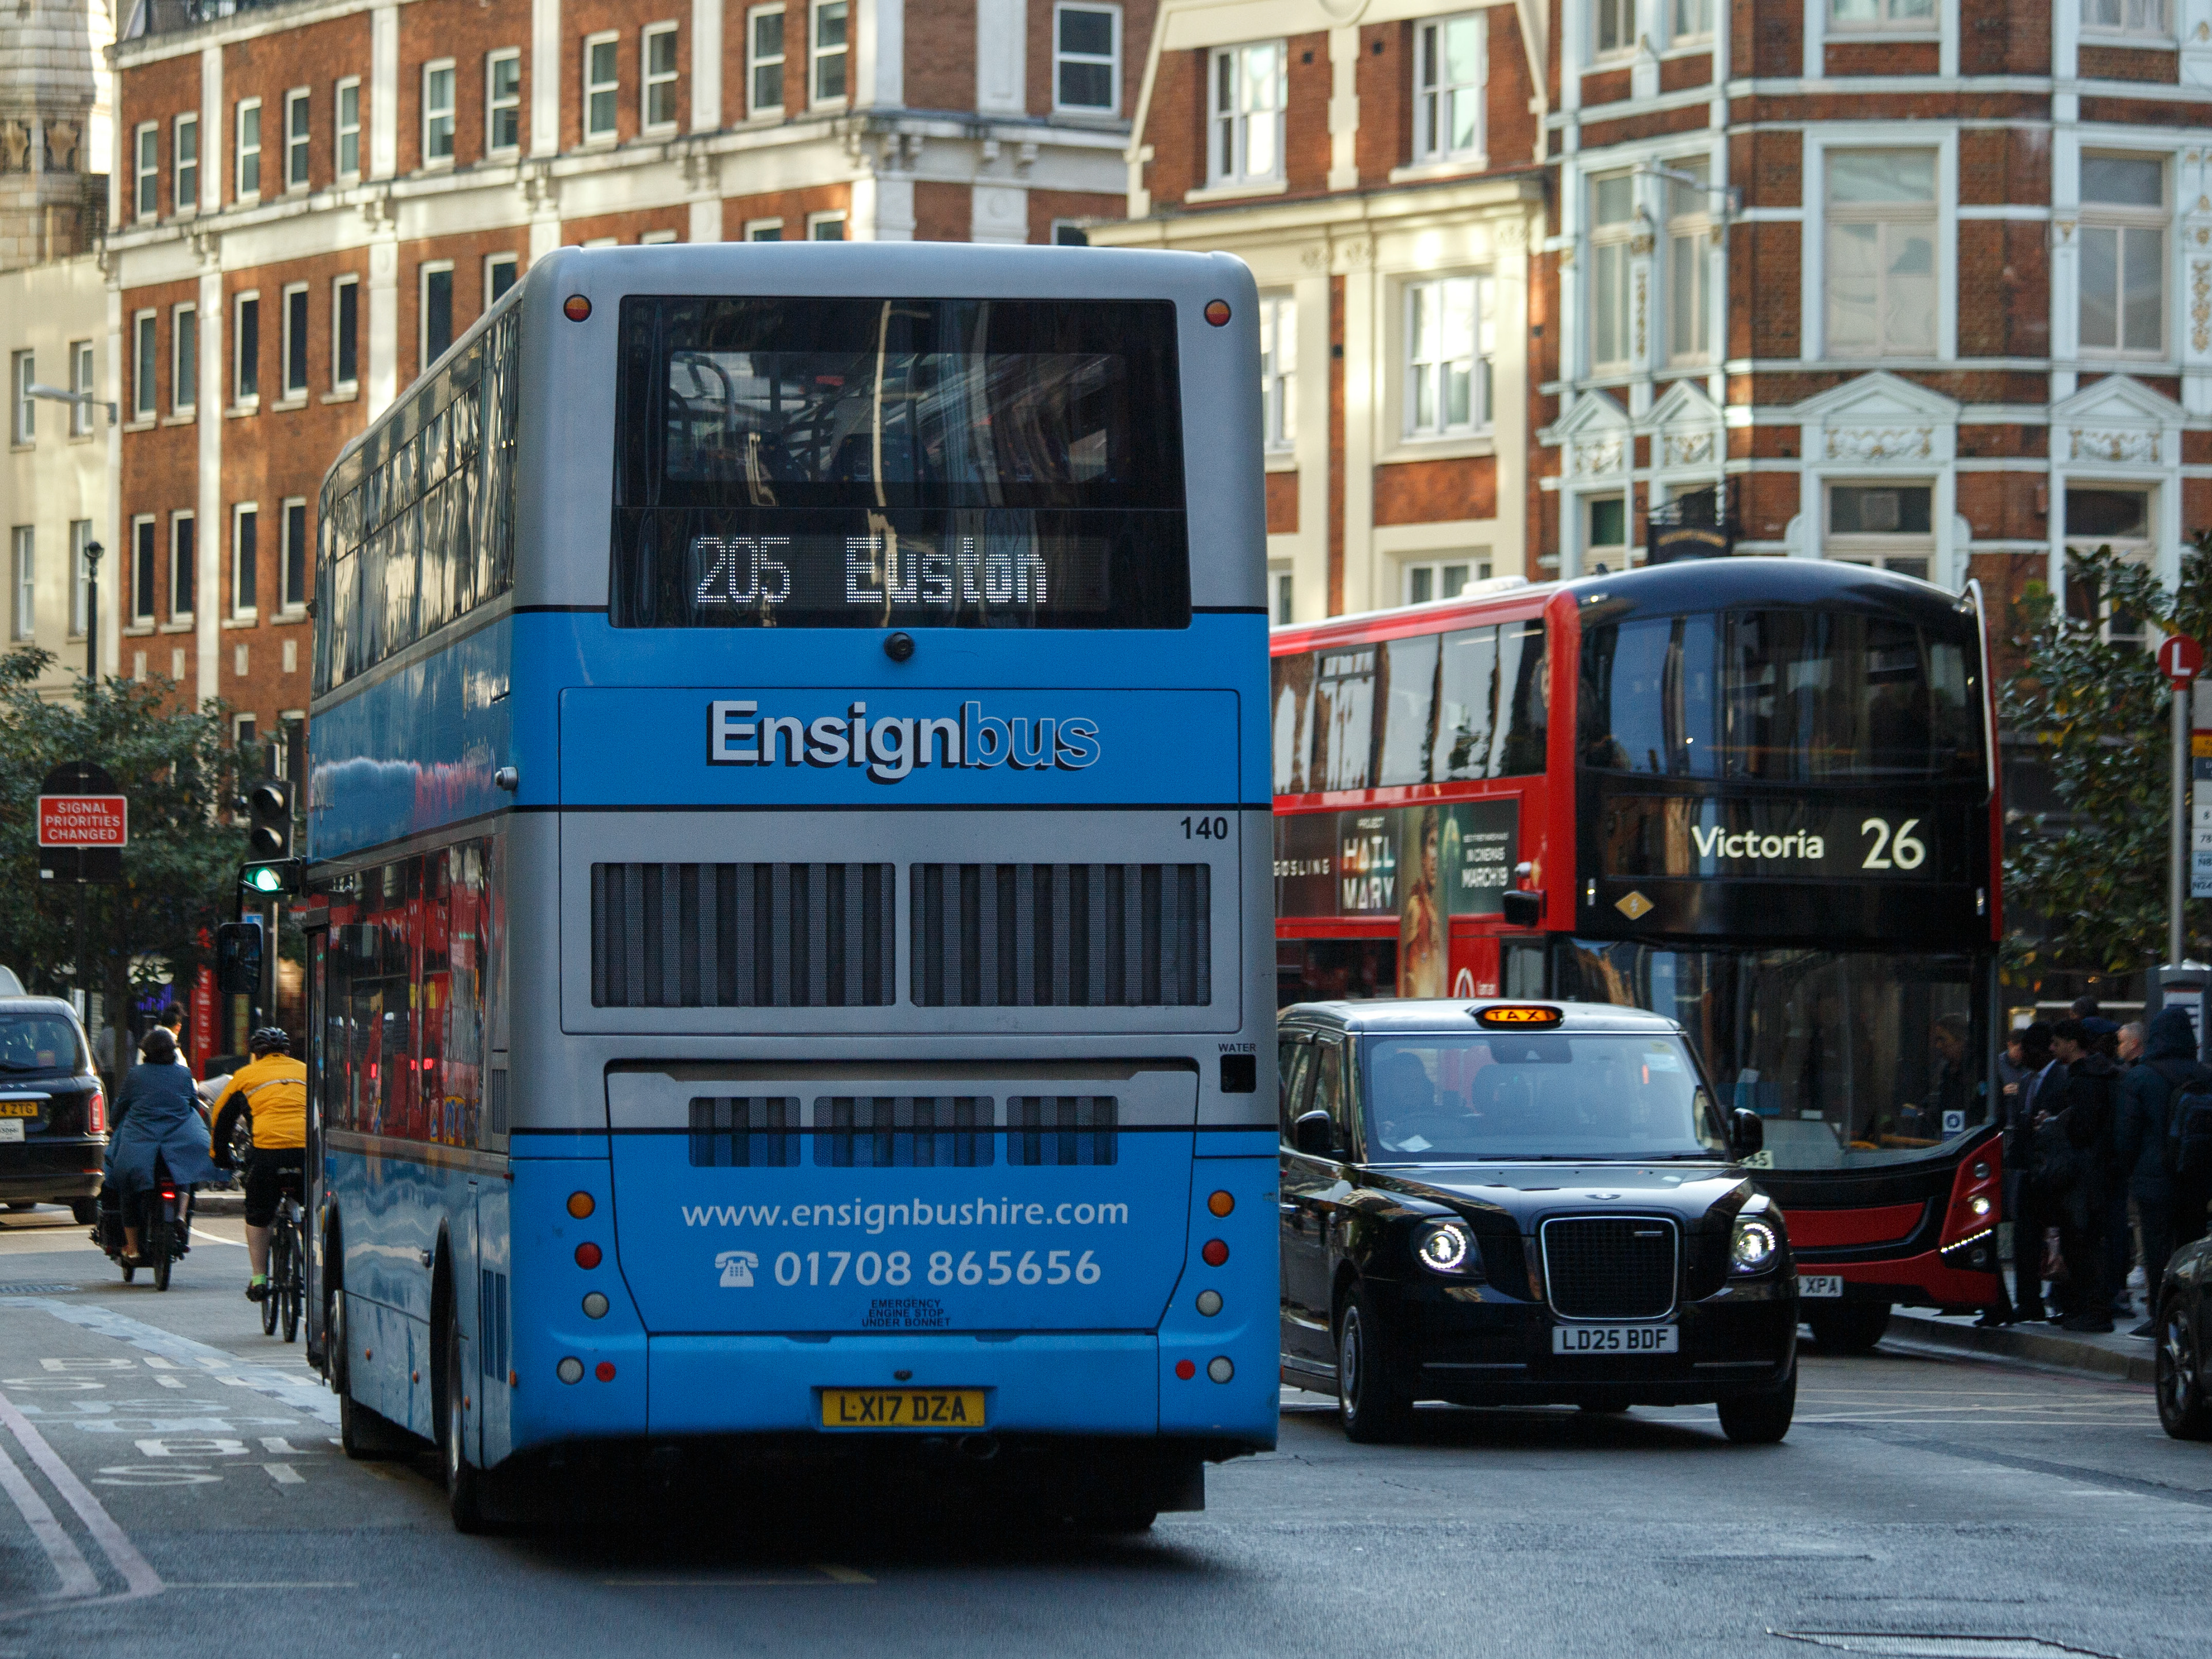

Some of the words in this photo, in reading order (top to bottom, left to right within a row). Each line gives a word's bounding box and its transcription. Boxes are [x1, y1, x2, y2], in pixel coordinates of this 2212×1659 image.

[697, 537, 790, 603] 205
[846, 537, 1047, 603] Euston
[2172, 642, 2192, 676] L
[706, 700, 1101, 786] Ensignbus
[58, 802, 108, 813] SIGNAL
[45, 815, 120, 827] PRIORITIES
[1181, 816, 1228, 840] 140
[48, 829, 117, 840] CHANGED
[1691, 826, 1824, 859] Victoria
[1862, 818, 1925, 869] 26
[1343, 836, 1396, 869] HAIL
[1343, 876, 1395, 909] MARY
[1491, 1011, 1551, 1020] TAXI
[1218, 1043, 1256, 1053] WATER
[11, 1103, 33, 1116] ZTG
[682, 1198, 1128, 1234] www.ensignbushire.com
[775, 1251, 911, 1286] 01708
[927, 1251, 1101, 1286] 865656
[1806, 1278, 1838, 1293] XPA
[869, 1309, 910, 1317] ENGINE
[915, 1309, 944, 1317] STOP
[872, 1299, 941, 1308] EMERGENCY
[862, 1318, 900, 1327] UNDER
[905, 1317, 950, 1326] BONNET
[1563, 1330, 1619, 1350] LD25
[1627, 1328, 1668, 1350] BDF
[2, 1374, 330, 1391] STO
[840, 1396, 903, 1422] LX17
[912, 1396, 967, 1422] DZA
